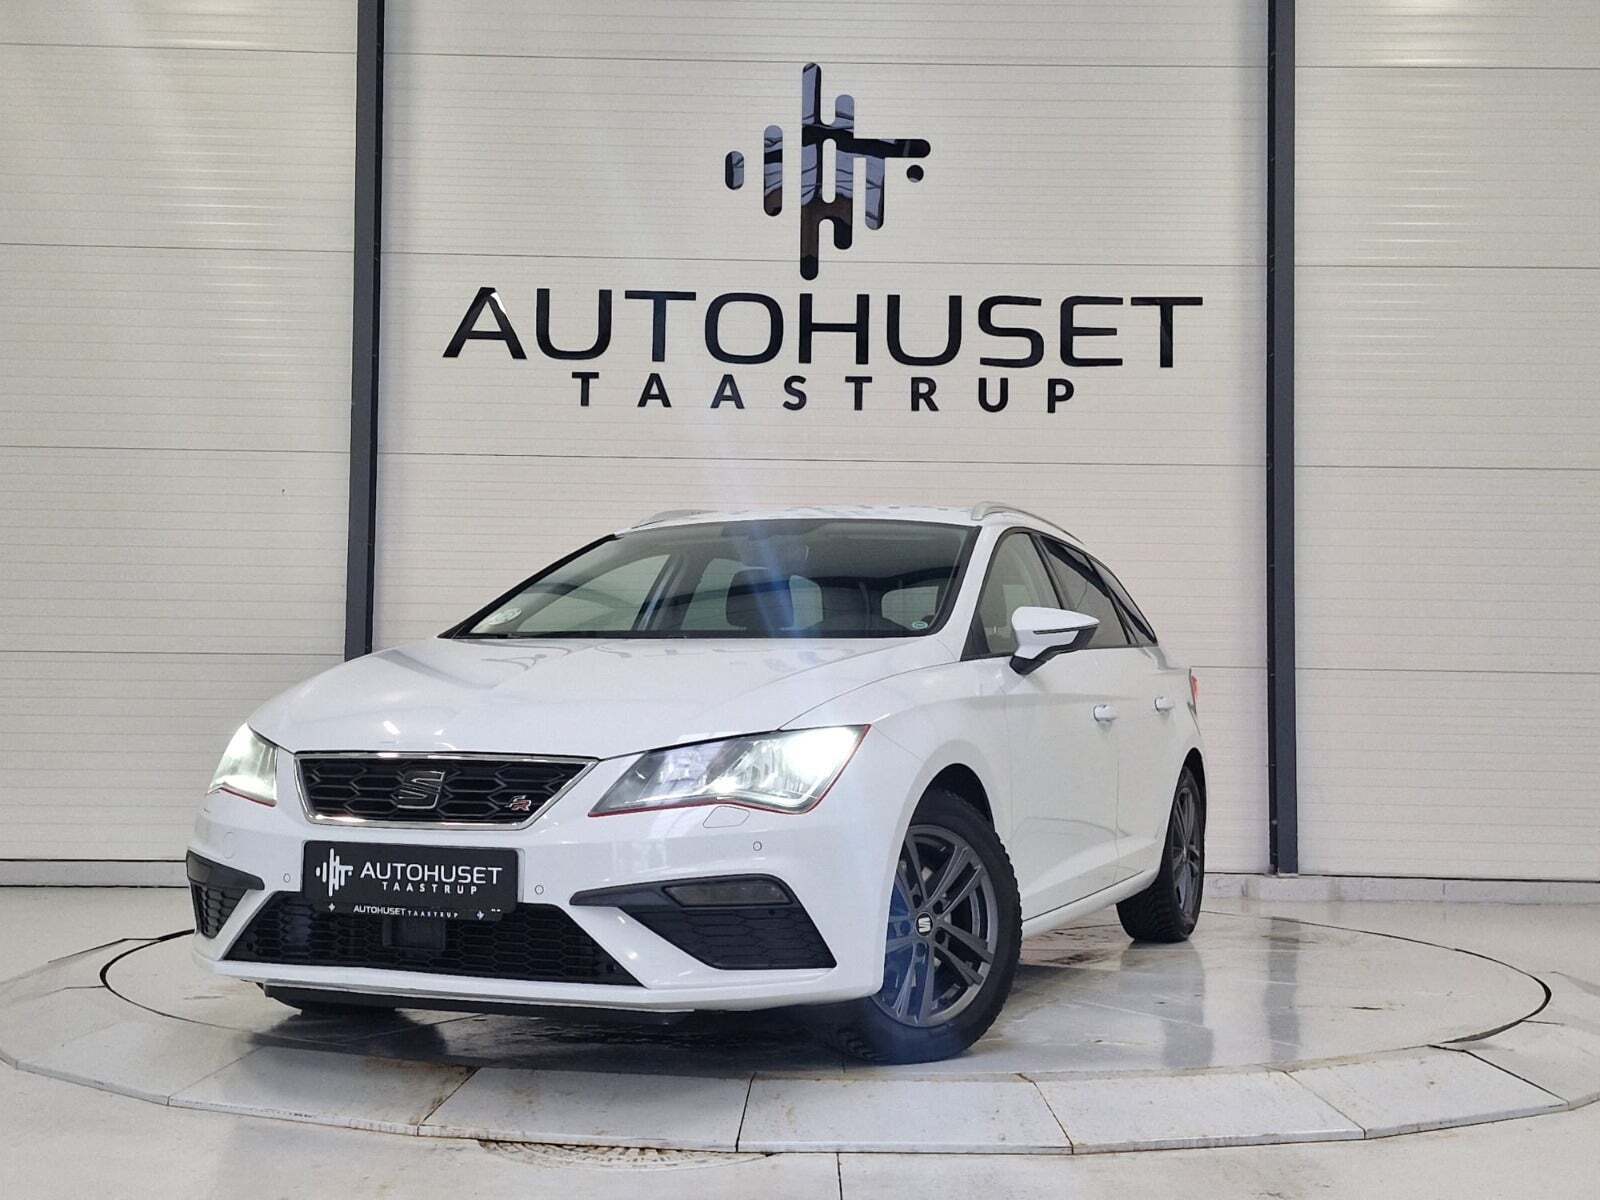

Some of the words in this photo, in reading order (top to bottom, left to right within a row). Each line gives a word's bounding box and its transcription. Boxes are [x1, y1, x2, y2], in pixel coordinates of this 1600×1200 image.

[442, 287, 1203, 368] AUTOHUSET
[571, 371, 1075, 414] TAASTRUP
[360, 861, 503, 885] AUTOHUSET
[382, 881, 478, 895] TAASTRUP
[353, 904, 406, 916] AUTOHUSET
[407, 909, 459, 918] TAASTRUP
